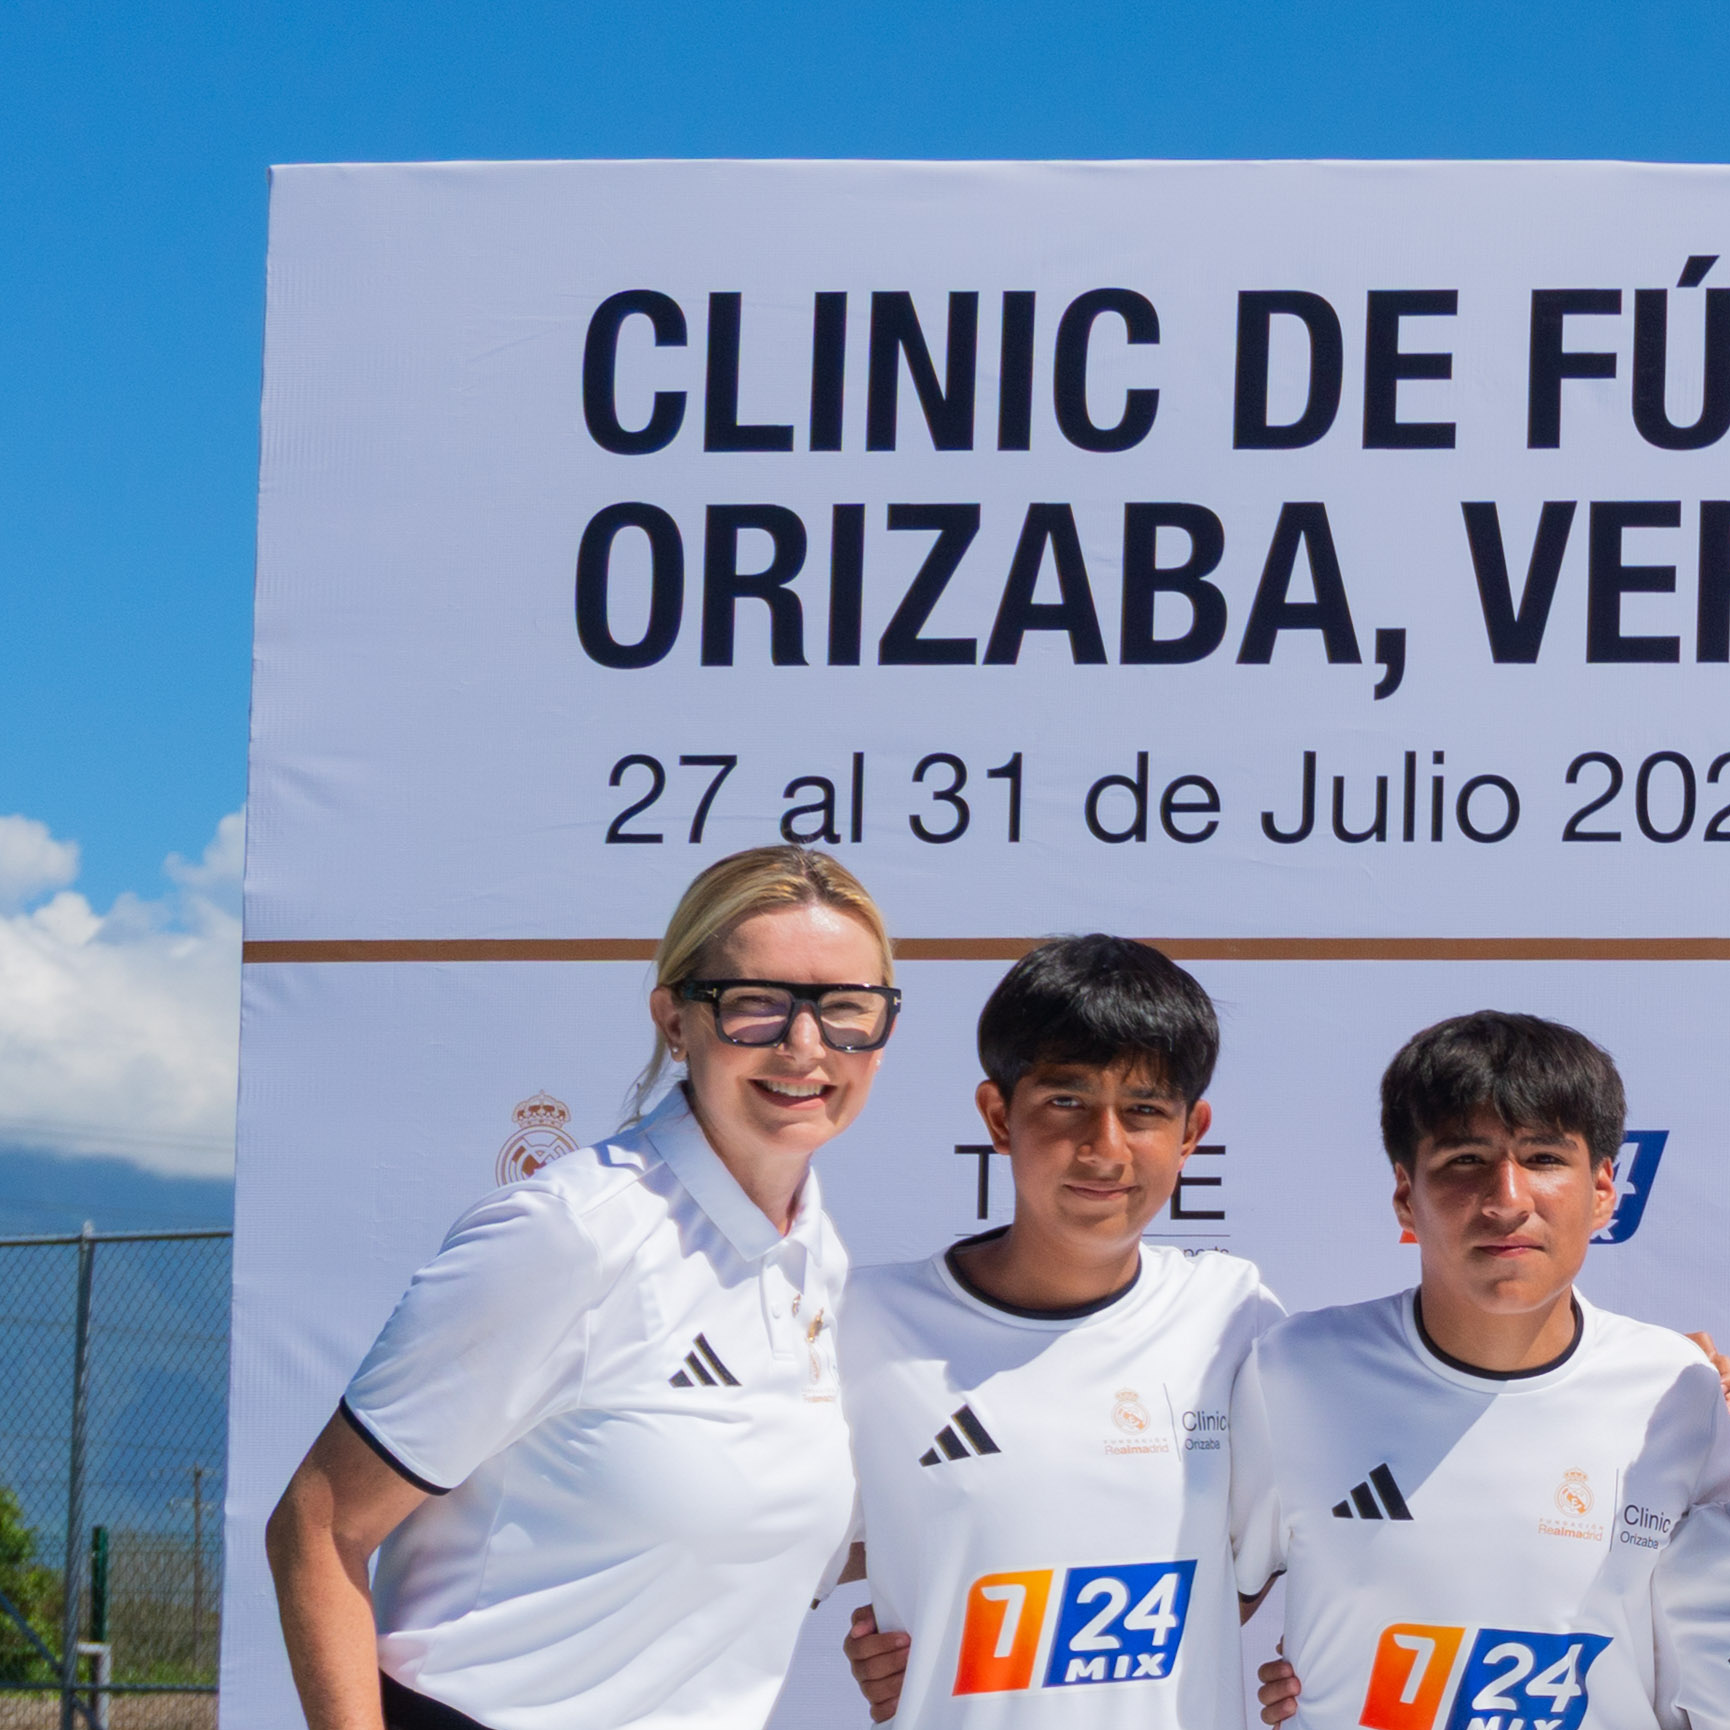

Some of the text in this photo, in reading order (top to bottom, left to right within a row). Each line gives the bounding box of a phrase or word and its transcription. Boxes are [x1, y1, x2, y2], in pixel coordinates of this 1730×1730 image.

[580, 287, 1160, 454] CLINIC
[1232, 288, 1458, 451] DE
[573, 499, 1408, 701] ORIZABA,
[605, 753, 737, 845] 27
[780, 753, 864, 845] al
[910, 752, 1021, 844] 31
[1083, 751, 1224, 844] de
[1260, 750, 1523, 843] Julio
[954, 1144, 1226, 1220] TE
[1182, 1410, 1228, 1432] Clinic
[1184, 1438, 1221, 1451] Orizaba
[1619, 1531, 1659, 1549] Orizaba
[1623, 1504, 1672, 1534] Clinic
[1068, 1572, 1180, 1653] 24
[1064, 1653, 1167, 1683] MIX
[1471, 1644, 1583, 1713] 24
